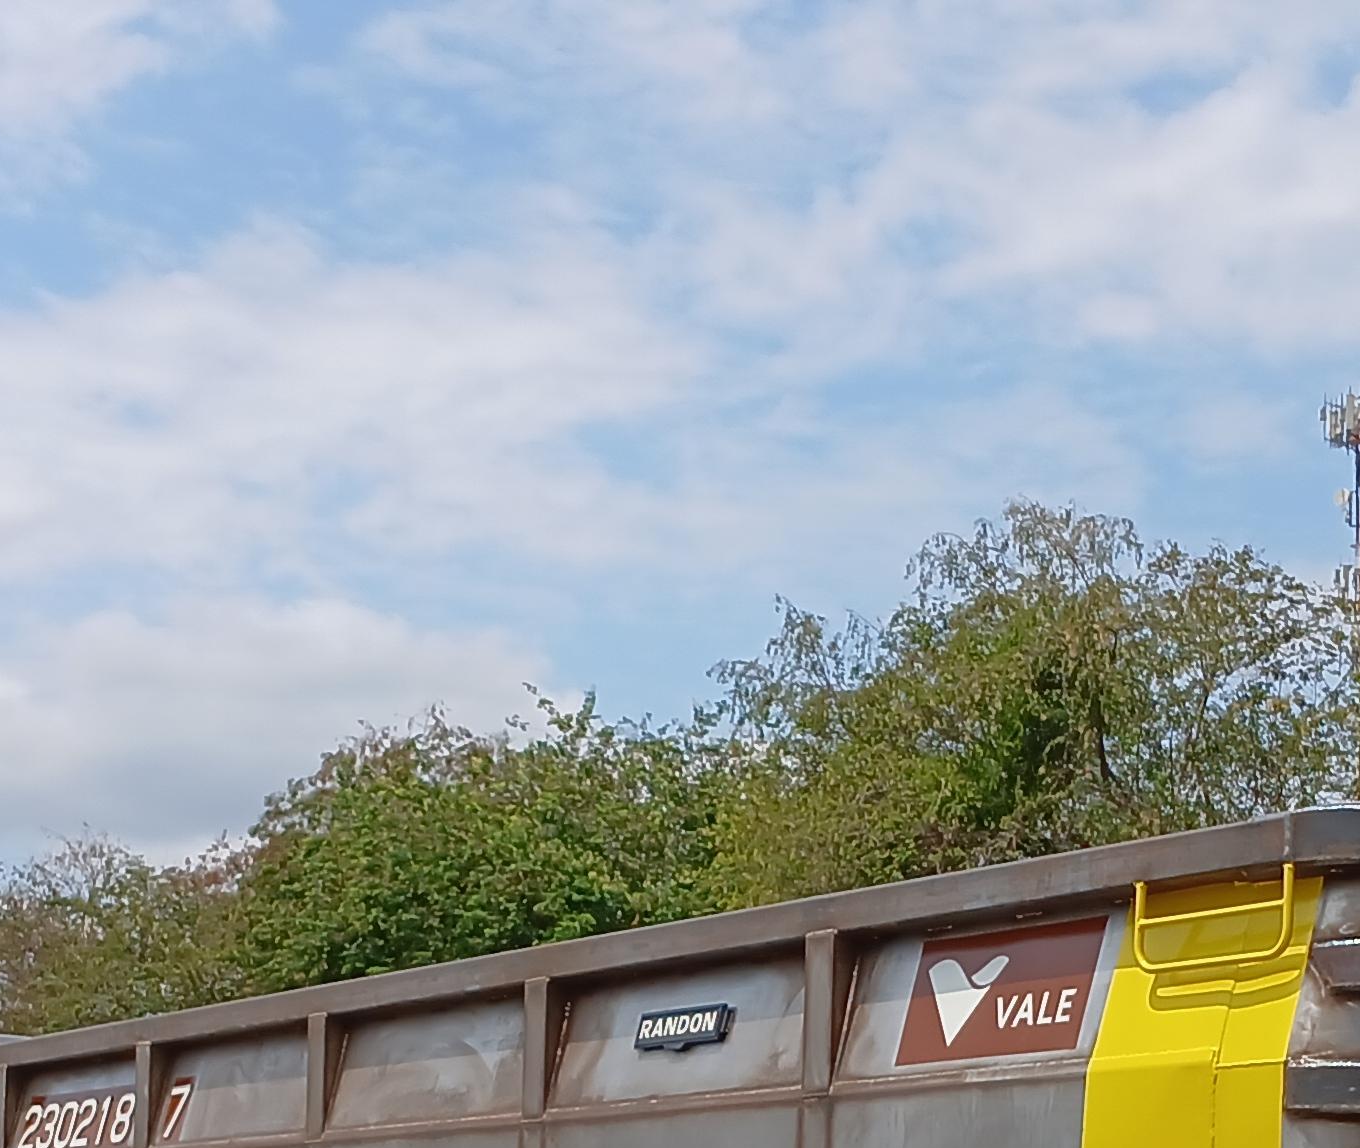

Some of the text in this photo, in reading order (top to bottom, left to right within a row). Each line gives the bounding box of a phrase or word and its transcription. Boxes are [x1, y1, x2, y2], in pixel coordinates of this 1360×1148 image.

[639, 1011, 718, 1040] RANDON
[996, 988, 1078, 1029] VALE
[163, 1084, 191, 1138] 7
